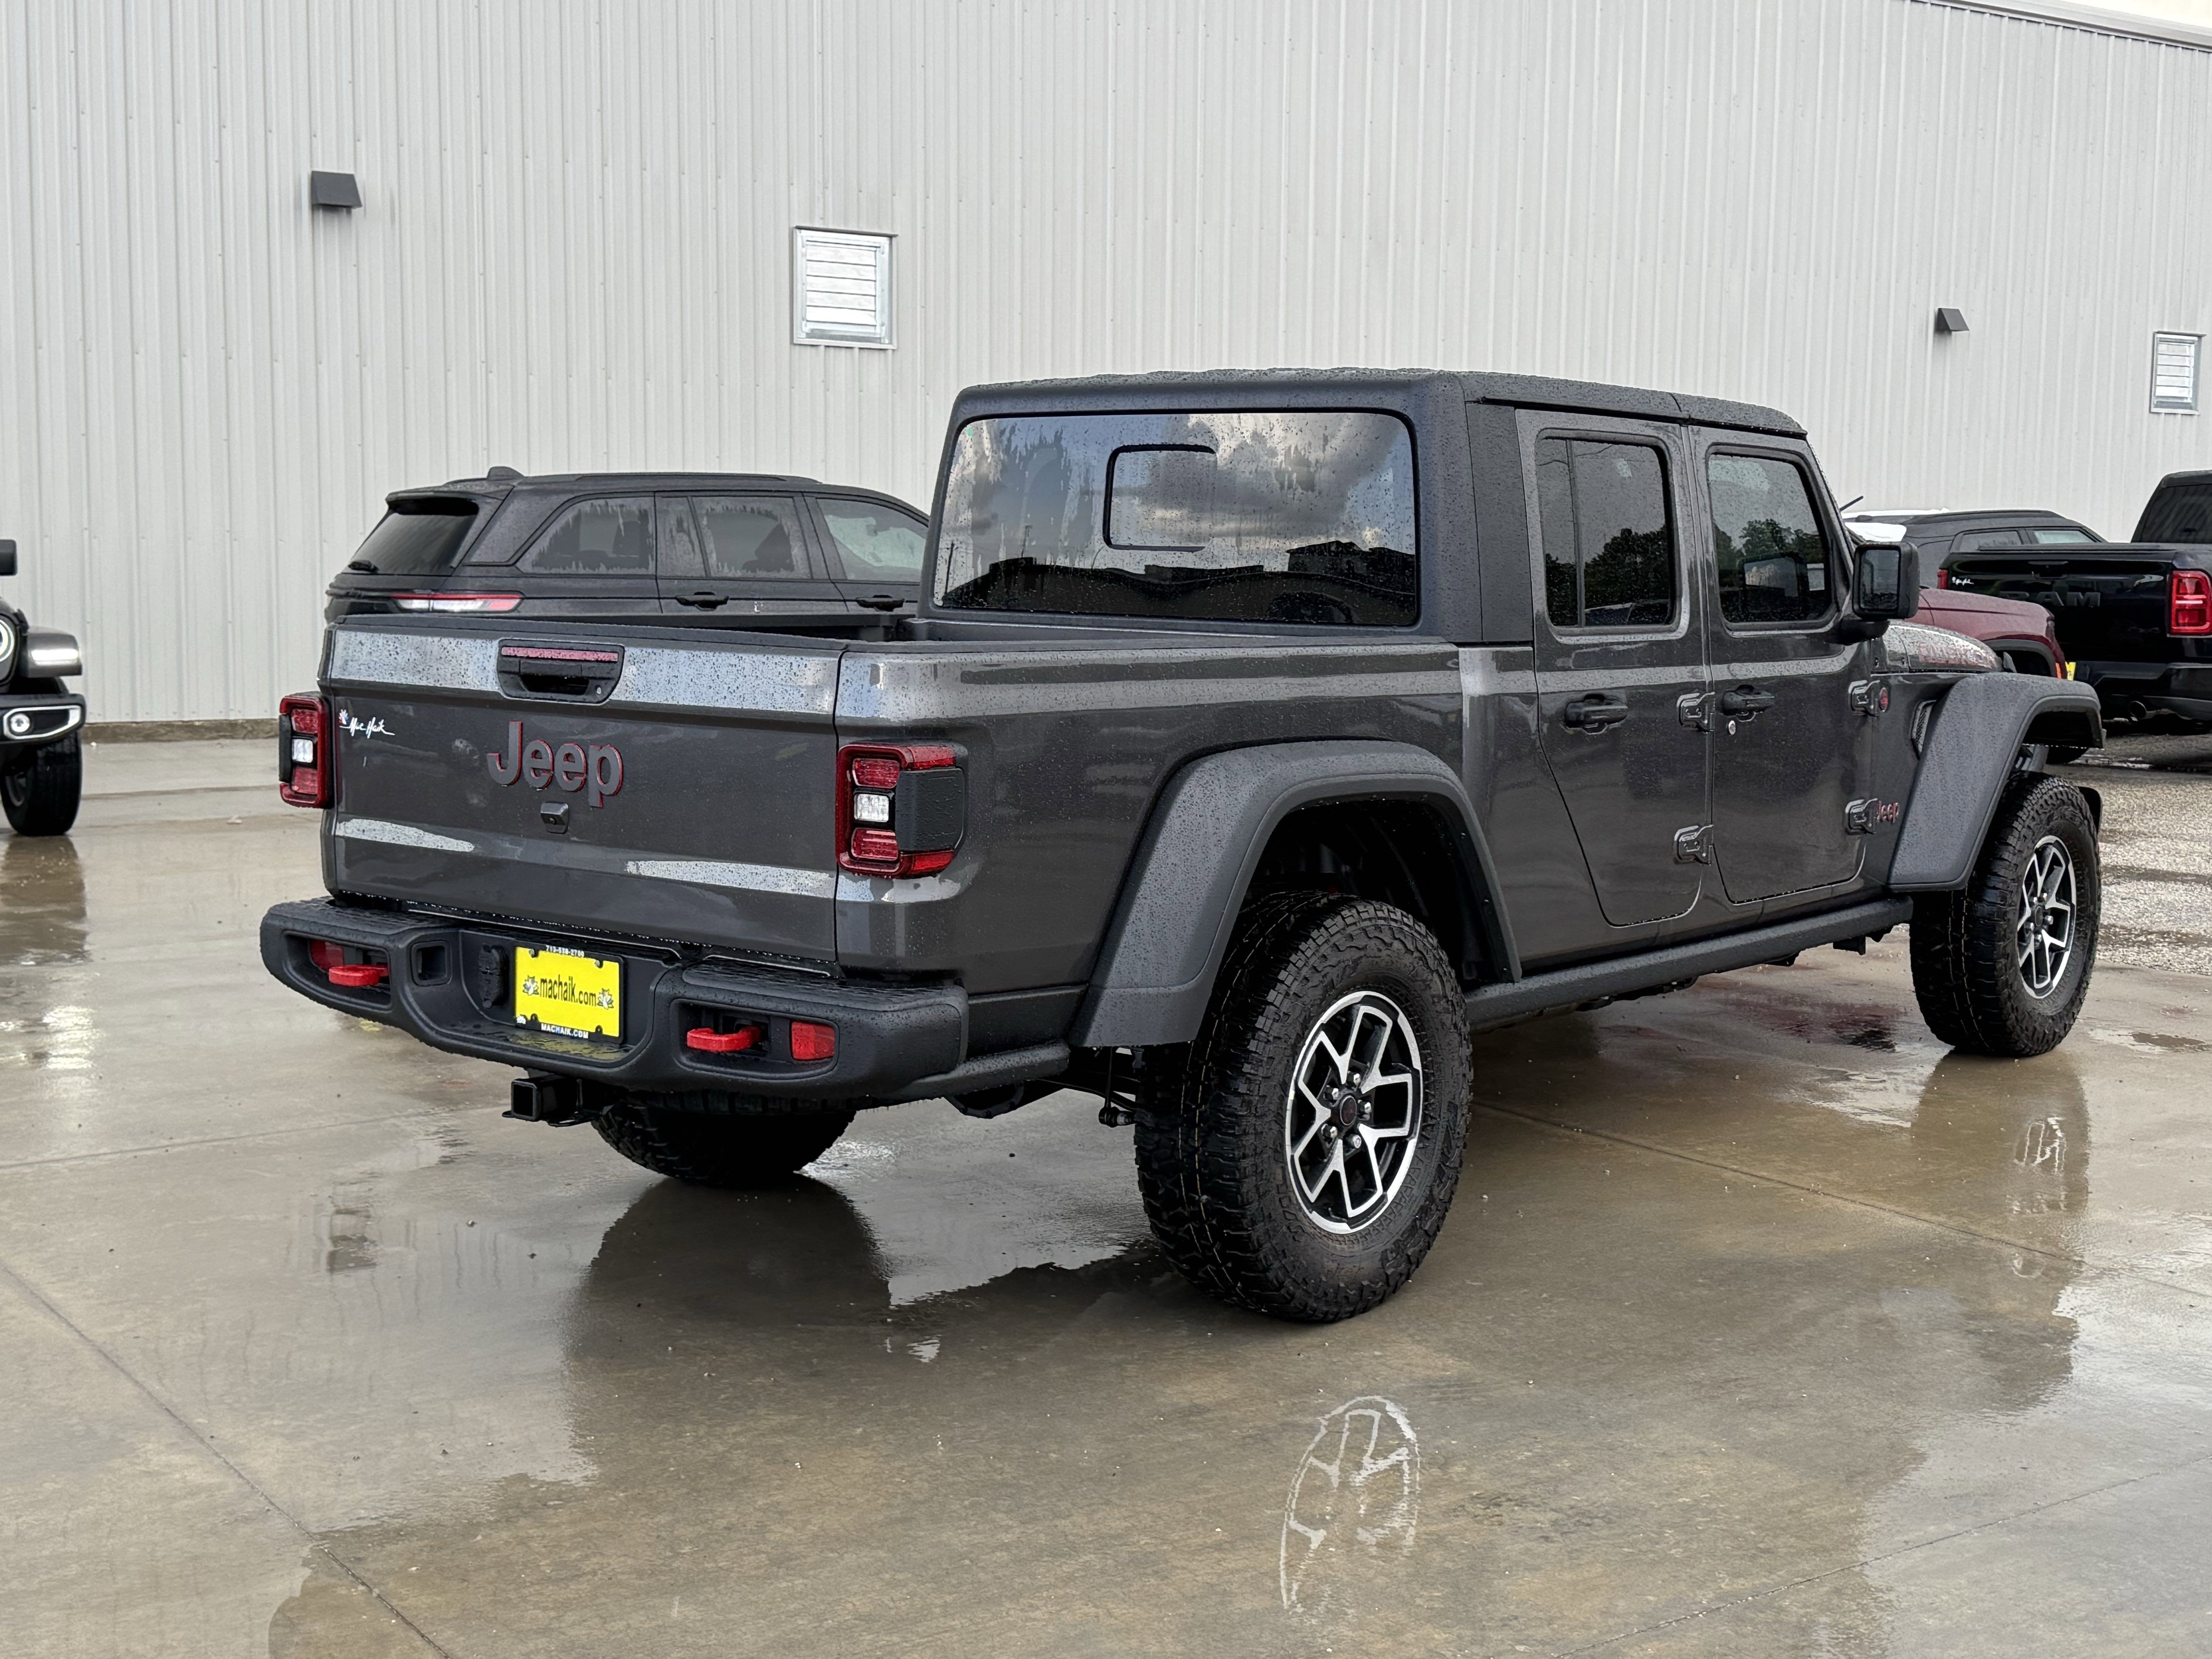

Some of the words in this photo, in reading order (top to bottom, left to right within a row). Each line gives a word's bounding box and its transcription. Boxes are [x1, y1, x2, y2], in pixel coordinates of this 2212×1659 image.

[366, 717, 395, 738] Haik
[487, 721, 623, 808] Jeep
[540, 974, 597, 1006] machaik.com
[541, 1023, 589, 1039] MACHAIK.COM
